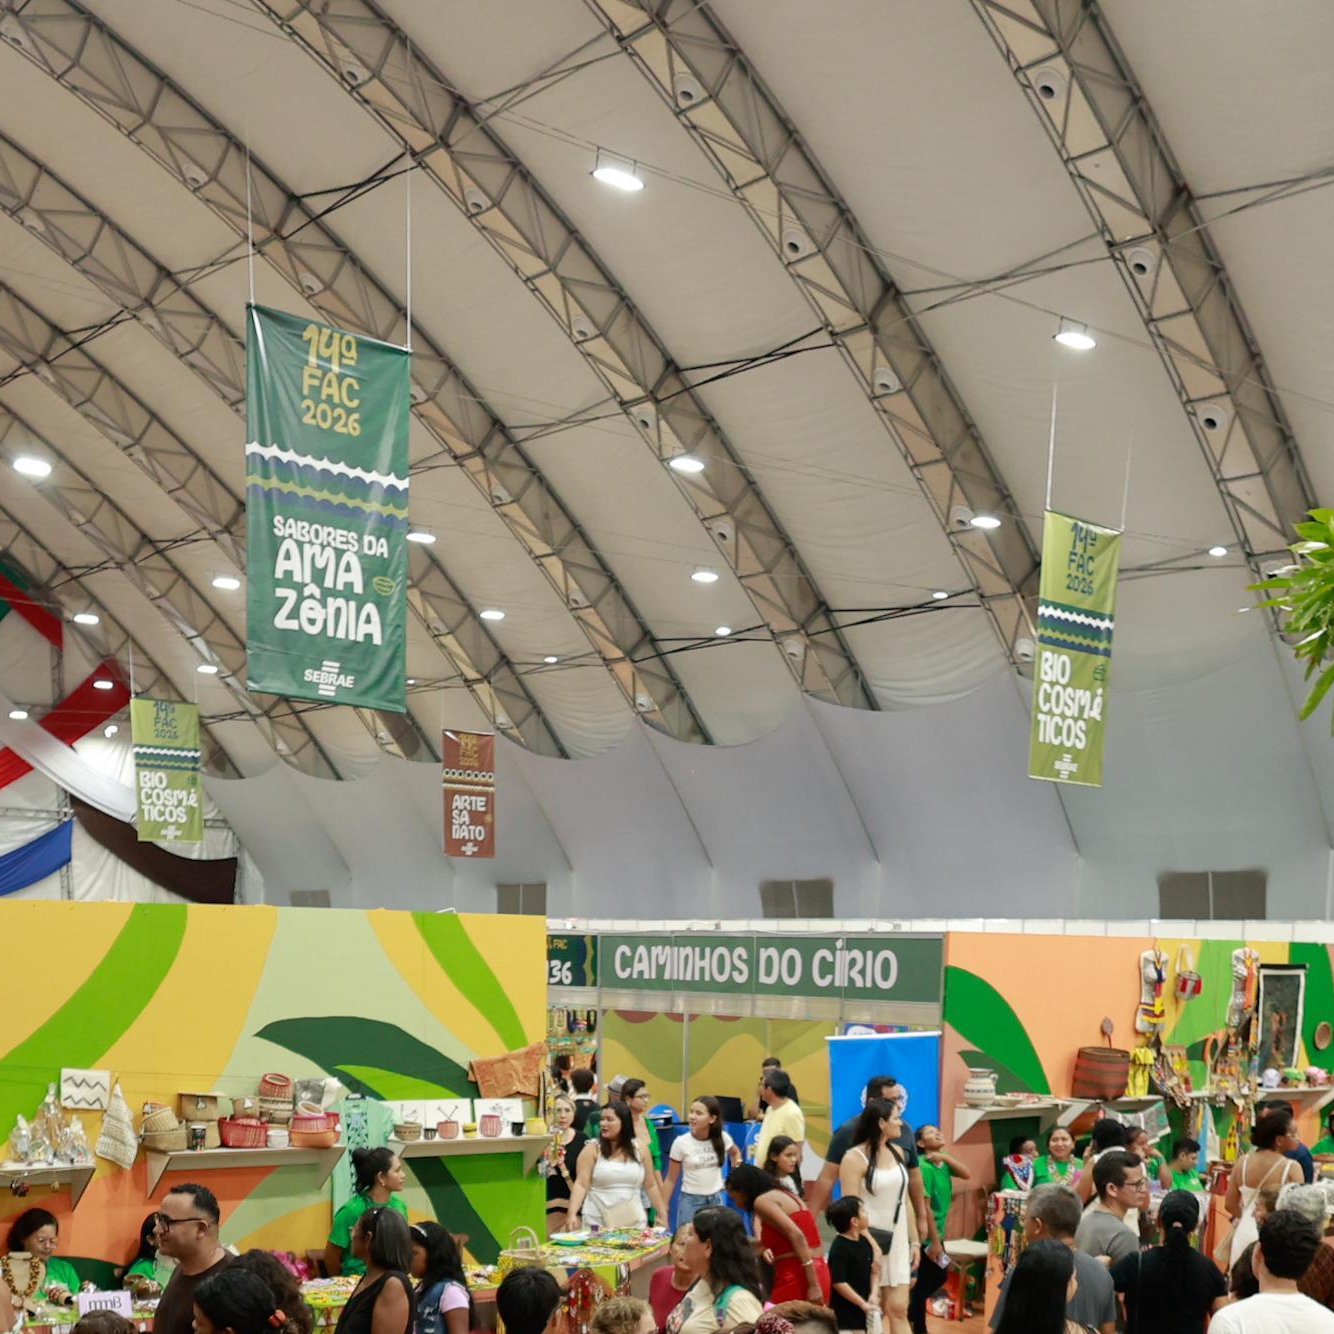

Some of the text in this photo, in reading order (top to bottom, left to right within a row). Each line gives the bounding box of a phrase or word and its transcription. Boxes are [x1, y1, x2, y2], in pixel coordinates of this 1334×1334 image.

[302, 367, 360, 407] FAC
[300, 400, 361, 436] 2026
[273, 515, 388, 558] SABORES DA
[274, 538, 363, 594] AMA
[1068, 551, 1095, 576] FAC
[1066, 573, 1094, 595] 2026
[273, 583, 382, 645] ZÔNIA
[304, 668, 355, 688] SEBRAE
[1040, 651, 1071, 685] BIO
[1037, 712, 1087, 750] TICOS
[139, 771, 167, 788] BIO
[141, 804, 187, 823] TICOS
[452, 794, 486, 811] ARTE
[452, 810, 469, 824] SA
[548, 959, 572, 985] 36
[614, 938, 898, 990] CAMINHOS DO CÍRIO
